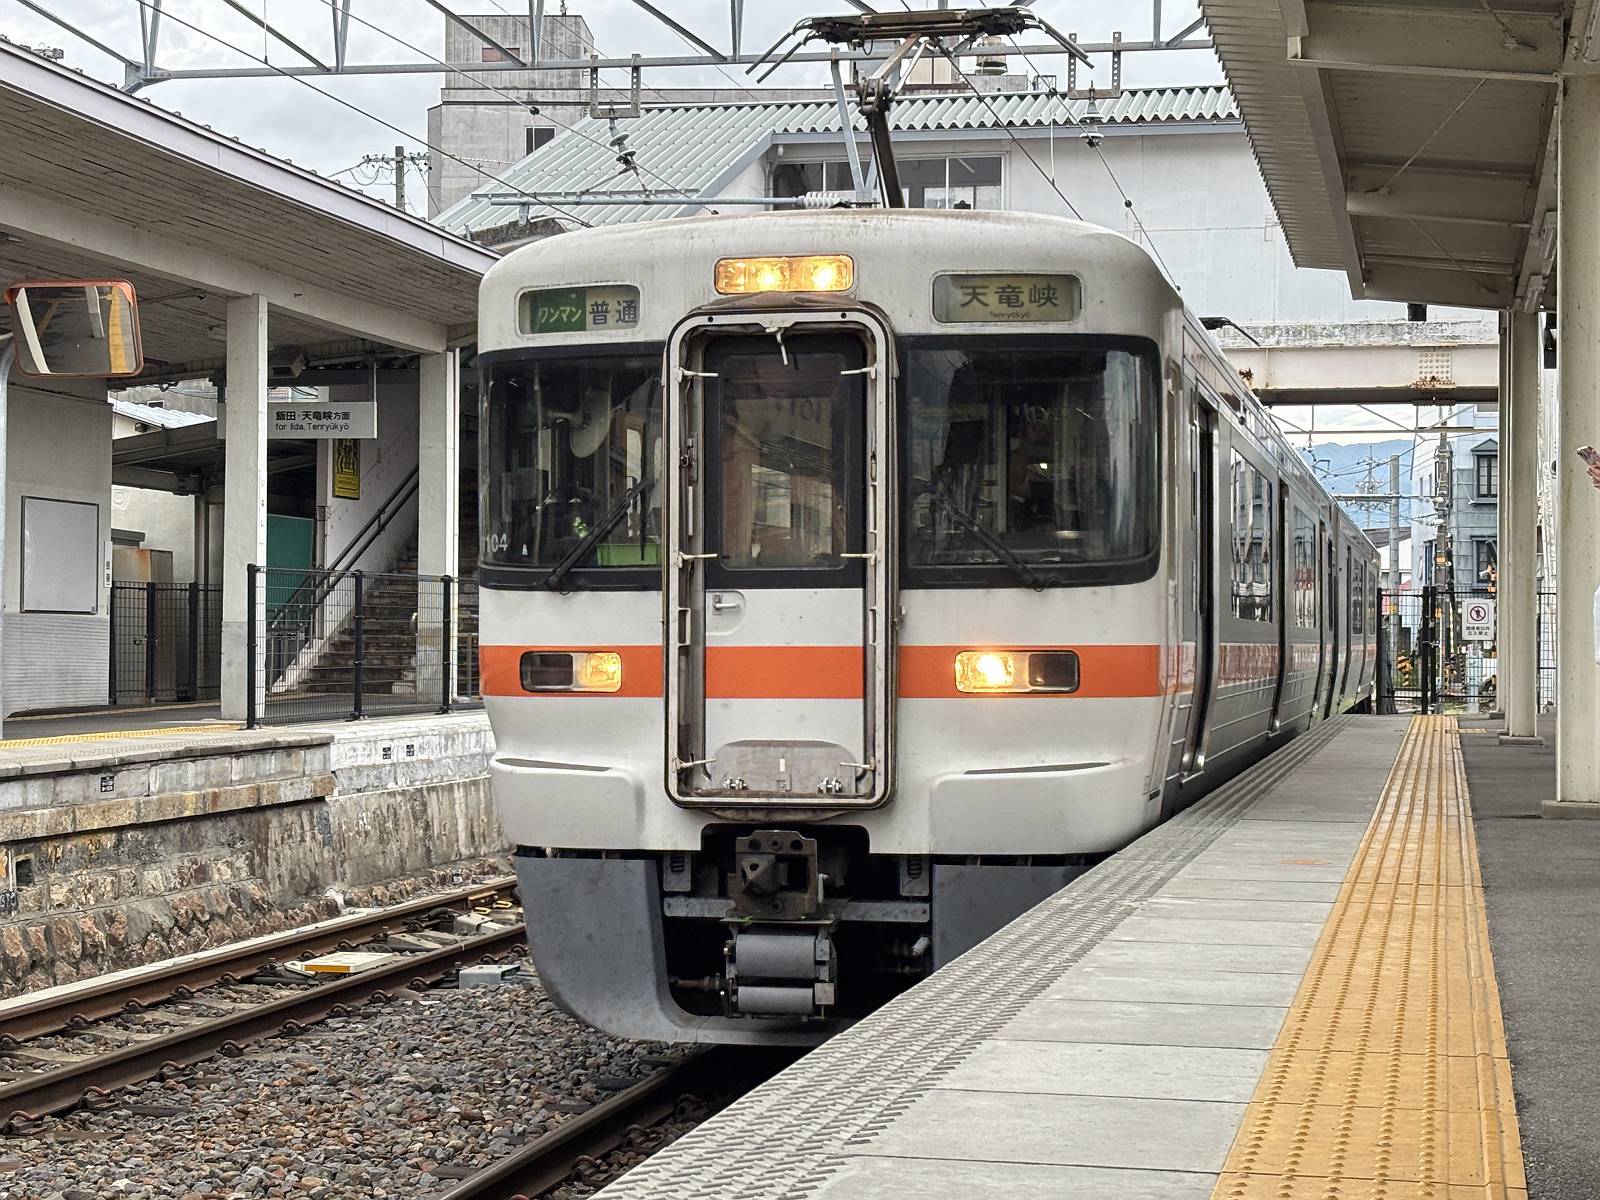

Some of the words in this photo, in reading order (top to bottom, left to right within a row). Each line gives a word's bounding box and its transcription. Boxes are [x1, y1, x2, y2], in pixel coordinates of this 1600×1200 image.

[960, 284, 1059, 308] 天竜峡
[539, 306, 582, 323] ワンマン
[589, 301, 637, 325] 普通
[275, 422, 287, 431] for
